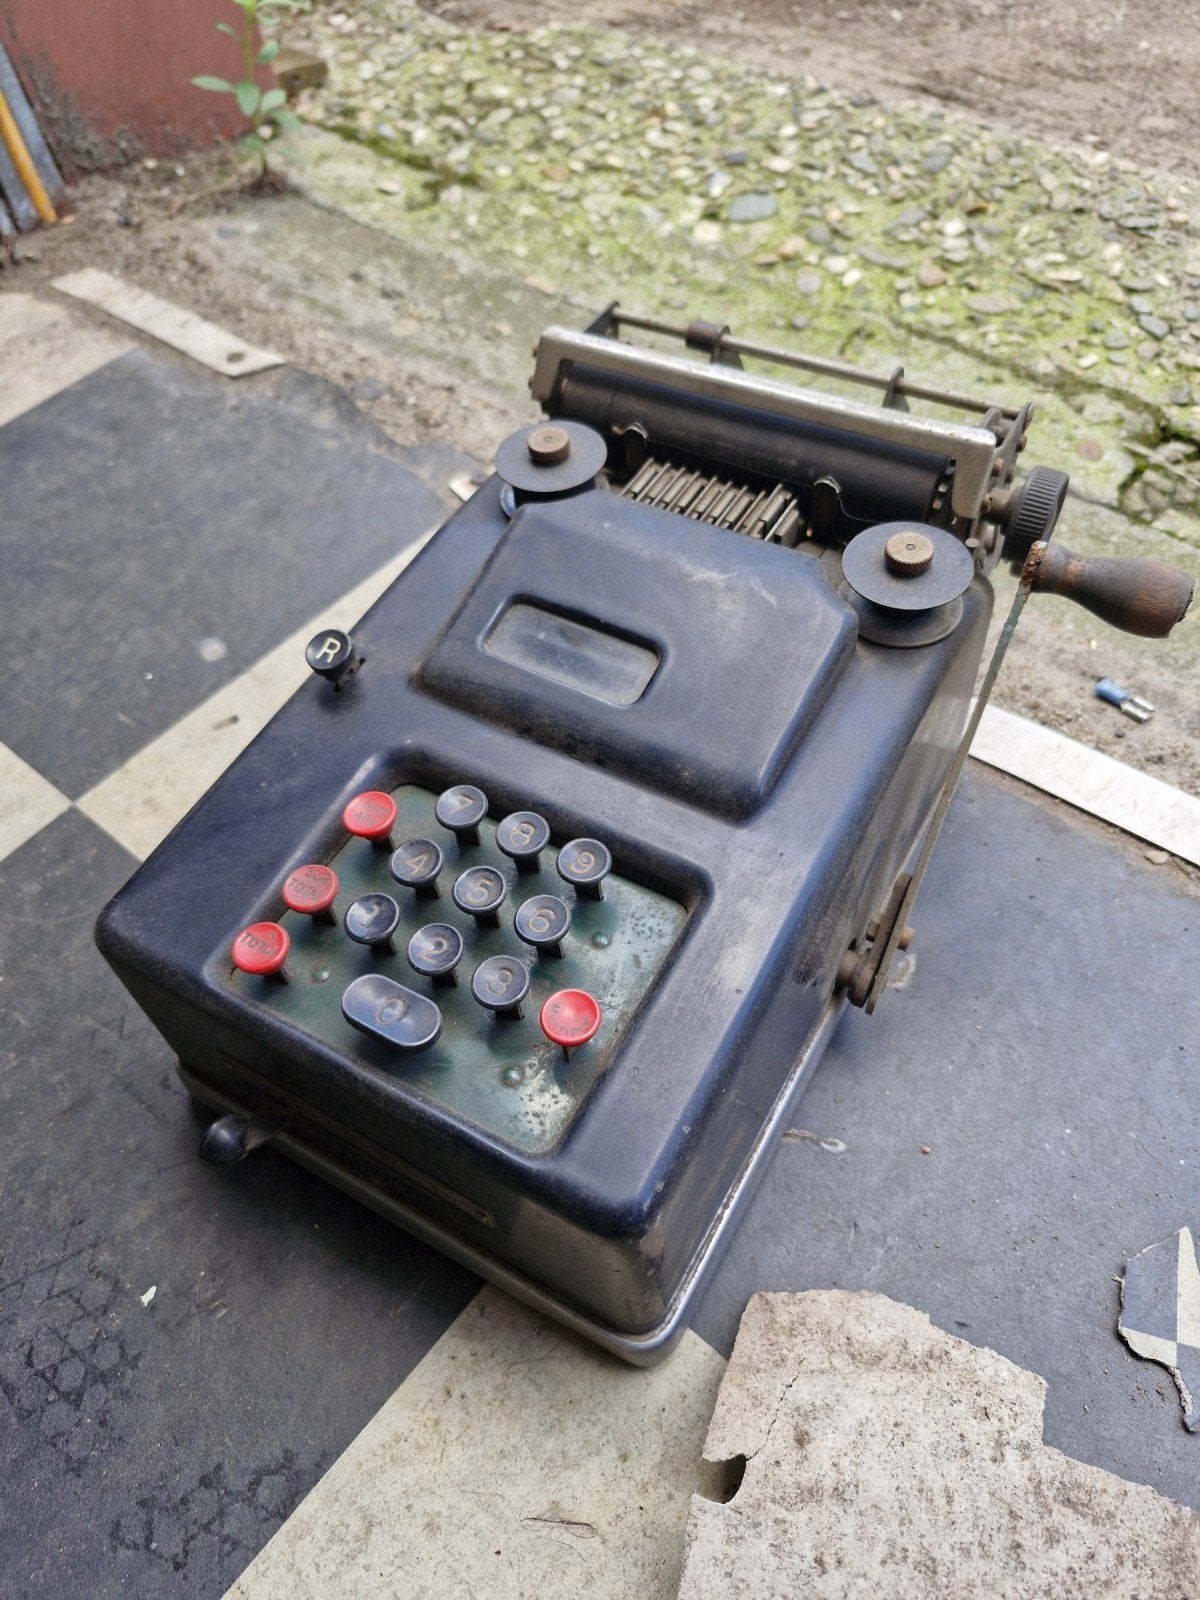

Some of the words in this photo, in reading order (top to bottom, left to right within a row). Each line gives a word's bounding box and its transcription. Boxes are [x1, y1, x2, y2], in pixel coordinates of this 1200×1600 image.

[316, 637, 341, 663] R
[447, 795, 474, 815] 7
[509, 822, 536, 846] 8
[405, 851, 429, 874] 4
[570, 851, 596, 874] 9
[467, 876, 494, 903] 5
[360, 904, 382, 927] 1
[529, 908, 556, 933] 6
[417, 936, 448, 964] 2
[485, 967, 513, 995] 3
